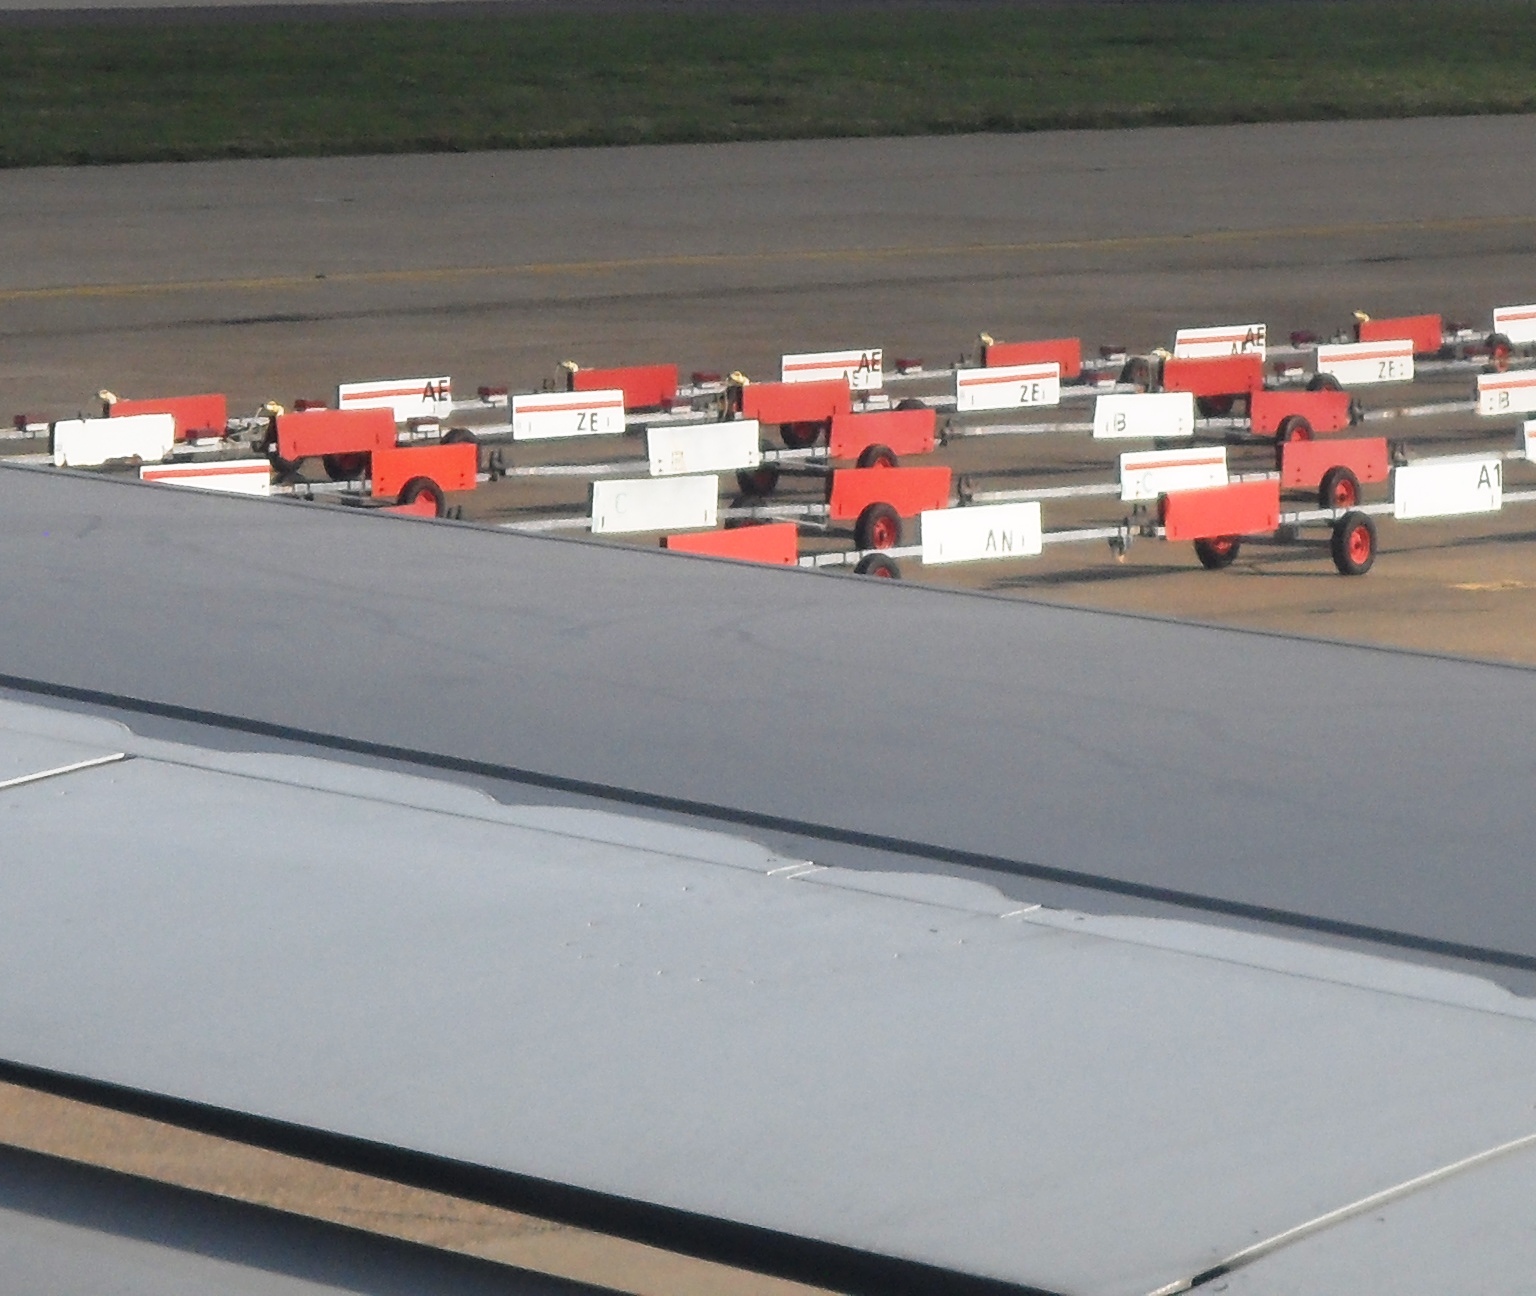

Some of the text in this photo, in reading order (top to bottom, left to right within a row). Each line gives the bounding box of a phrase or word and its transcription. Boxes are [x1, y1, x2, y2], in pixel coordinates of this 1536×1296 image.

[1243, 327, 1265, 348] AE
[857, 351, 881, 373] AE
[421, 380, 448, 403] AE
[1498, 391, 1510, 408] B
[576, 412, 598, 432] ZE
[985, 529, 1013, 552] AN
